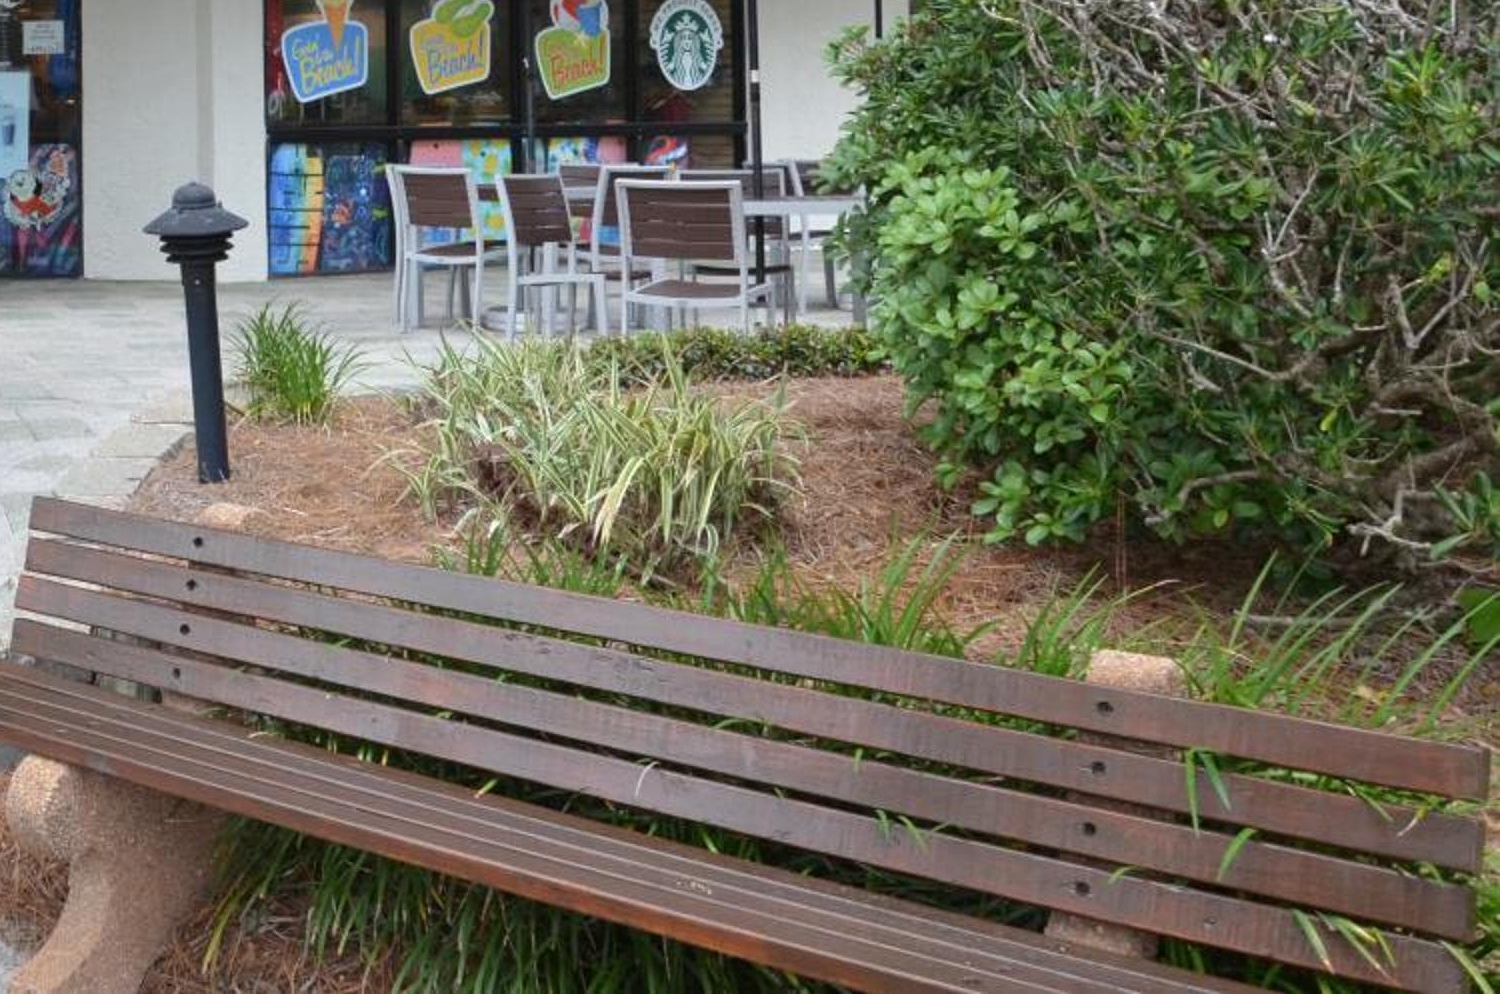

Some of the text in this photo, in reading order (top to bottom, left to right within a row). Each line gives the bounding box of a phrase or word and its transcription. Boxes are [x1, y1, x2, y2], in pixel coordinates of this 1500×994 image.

[299, 34, 362, 96] Beach!
[427, 29, 486, 86] Beach!
[550, 33, 606, 93] Beach!
